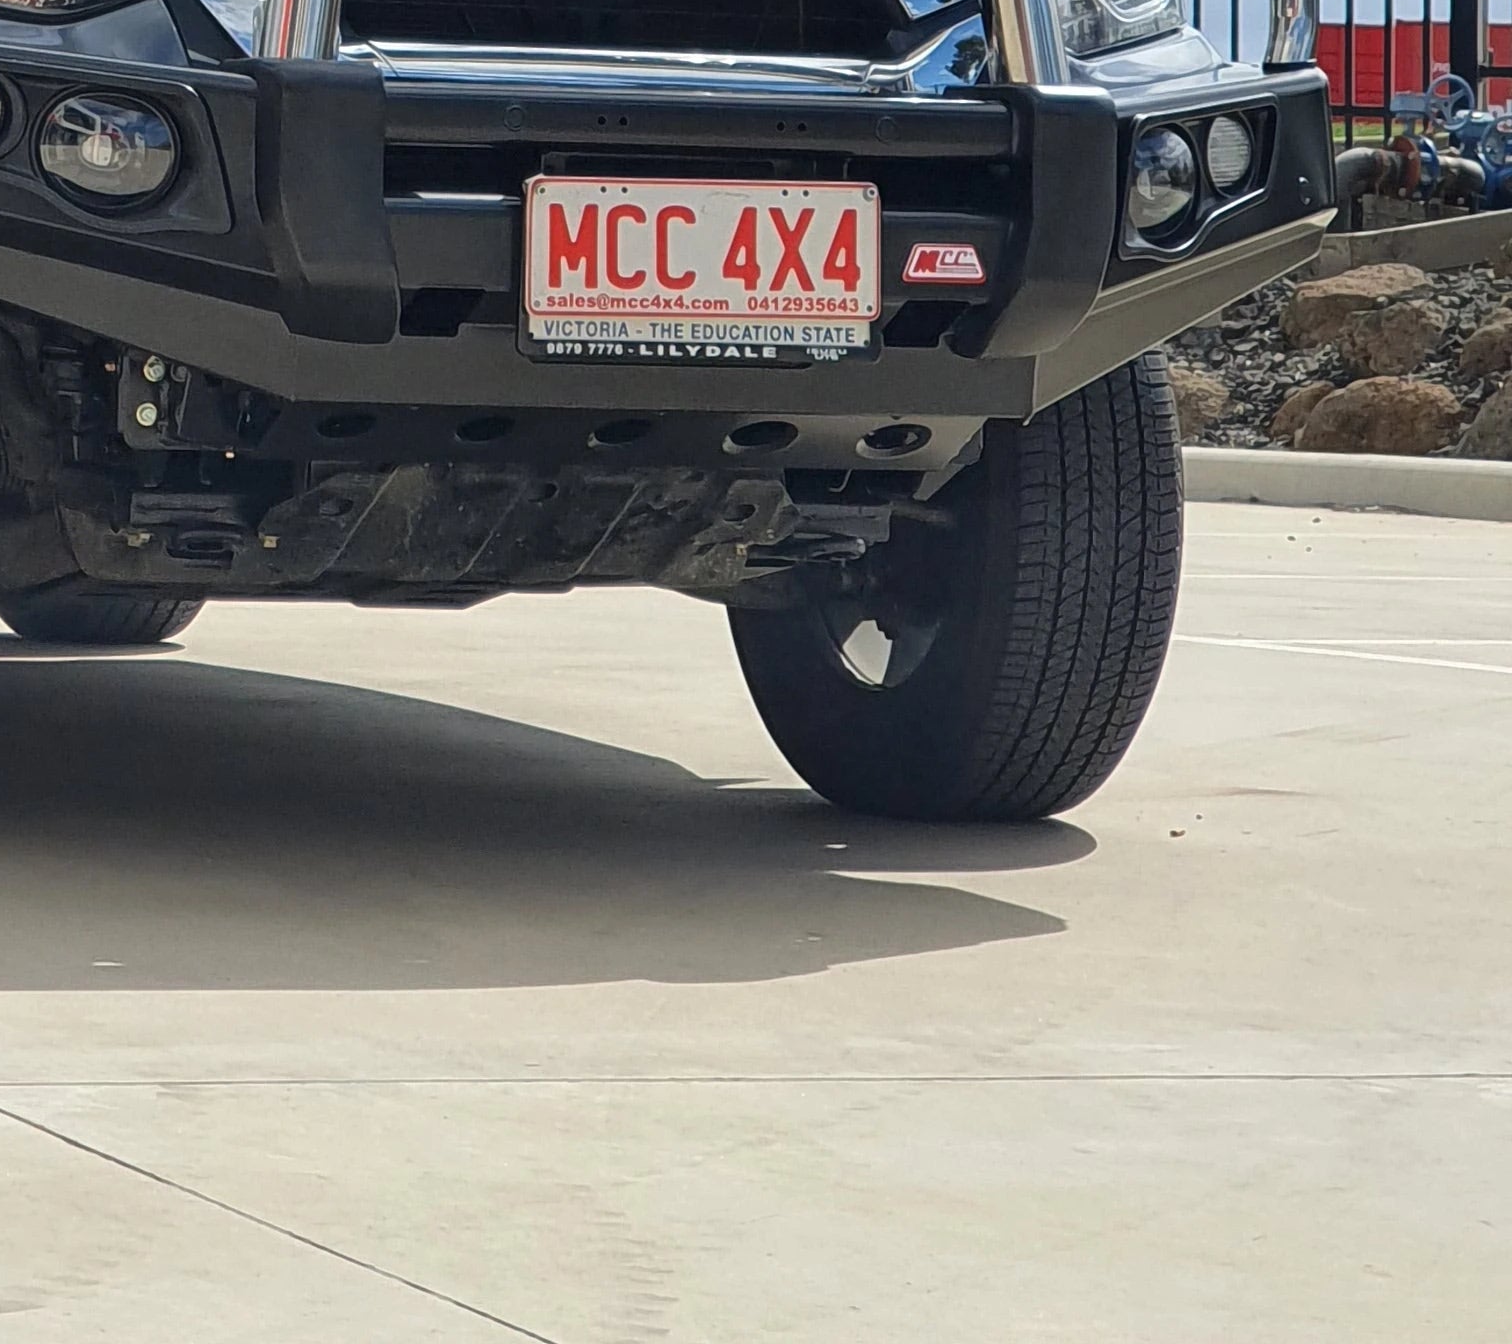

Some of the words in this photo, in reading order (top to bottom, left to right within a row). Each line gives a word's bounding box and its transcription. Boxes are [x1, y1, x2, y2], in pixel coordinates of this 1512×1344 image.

[546, 202, 698, 291] MCC
[722, 205, 861, 292] 4X4
[546, 293, 730, 311] sales@mcc4x4.com
[747, 296, 860, 313] 0412935643
[543, 320, 629, 338] VICTORIA
[649, 322, 684, 339] THE
[691, 324, 795, 342] EDUCATION
[802, 326, 856, 343] STATE
[639, 343, 778, 359] LILYDALE
